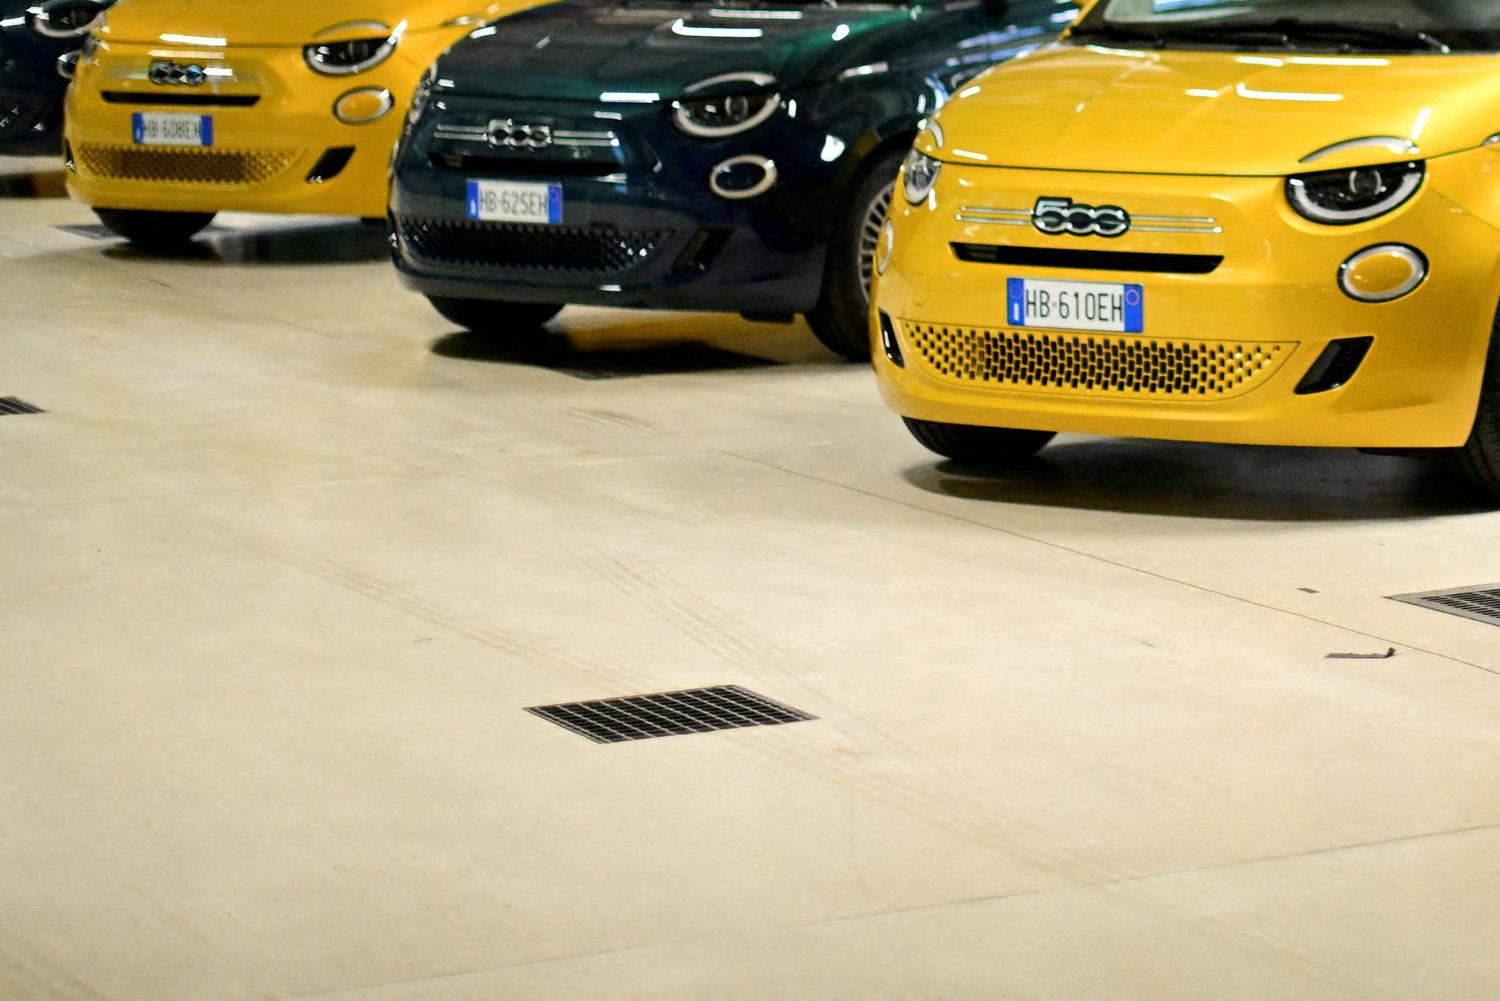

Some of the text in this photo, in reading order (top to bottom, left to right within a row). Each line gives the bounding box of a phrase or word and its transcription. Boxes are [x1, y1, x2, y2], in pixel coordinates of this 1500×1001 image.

[480, 188, 548, 217] HB 625EH
[1034, 198, 1128, 237] 500
[1026, 289, 1123, 323] HB 610EH
